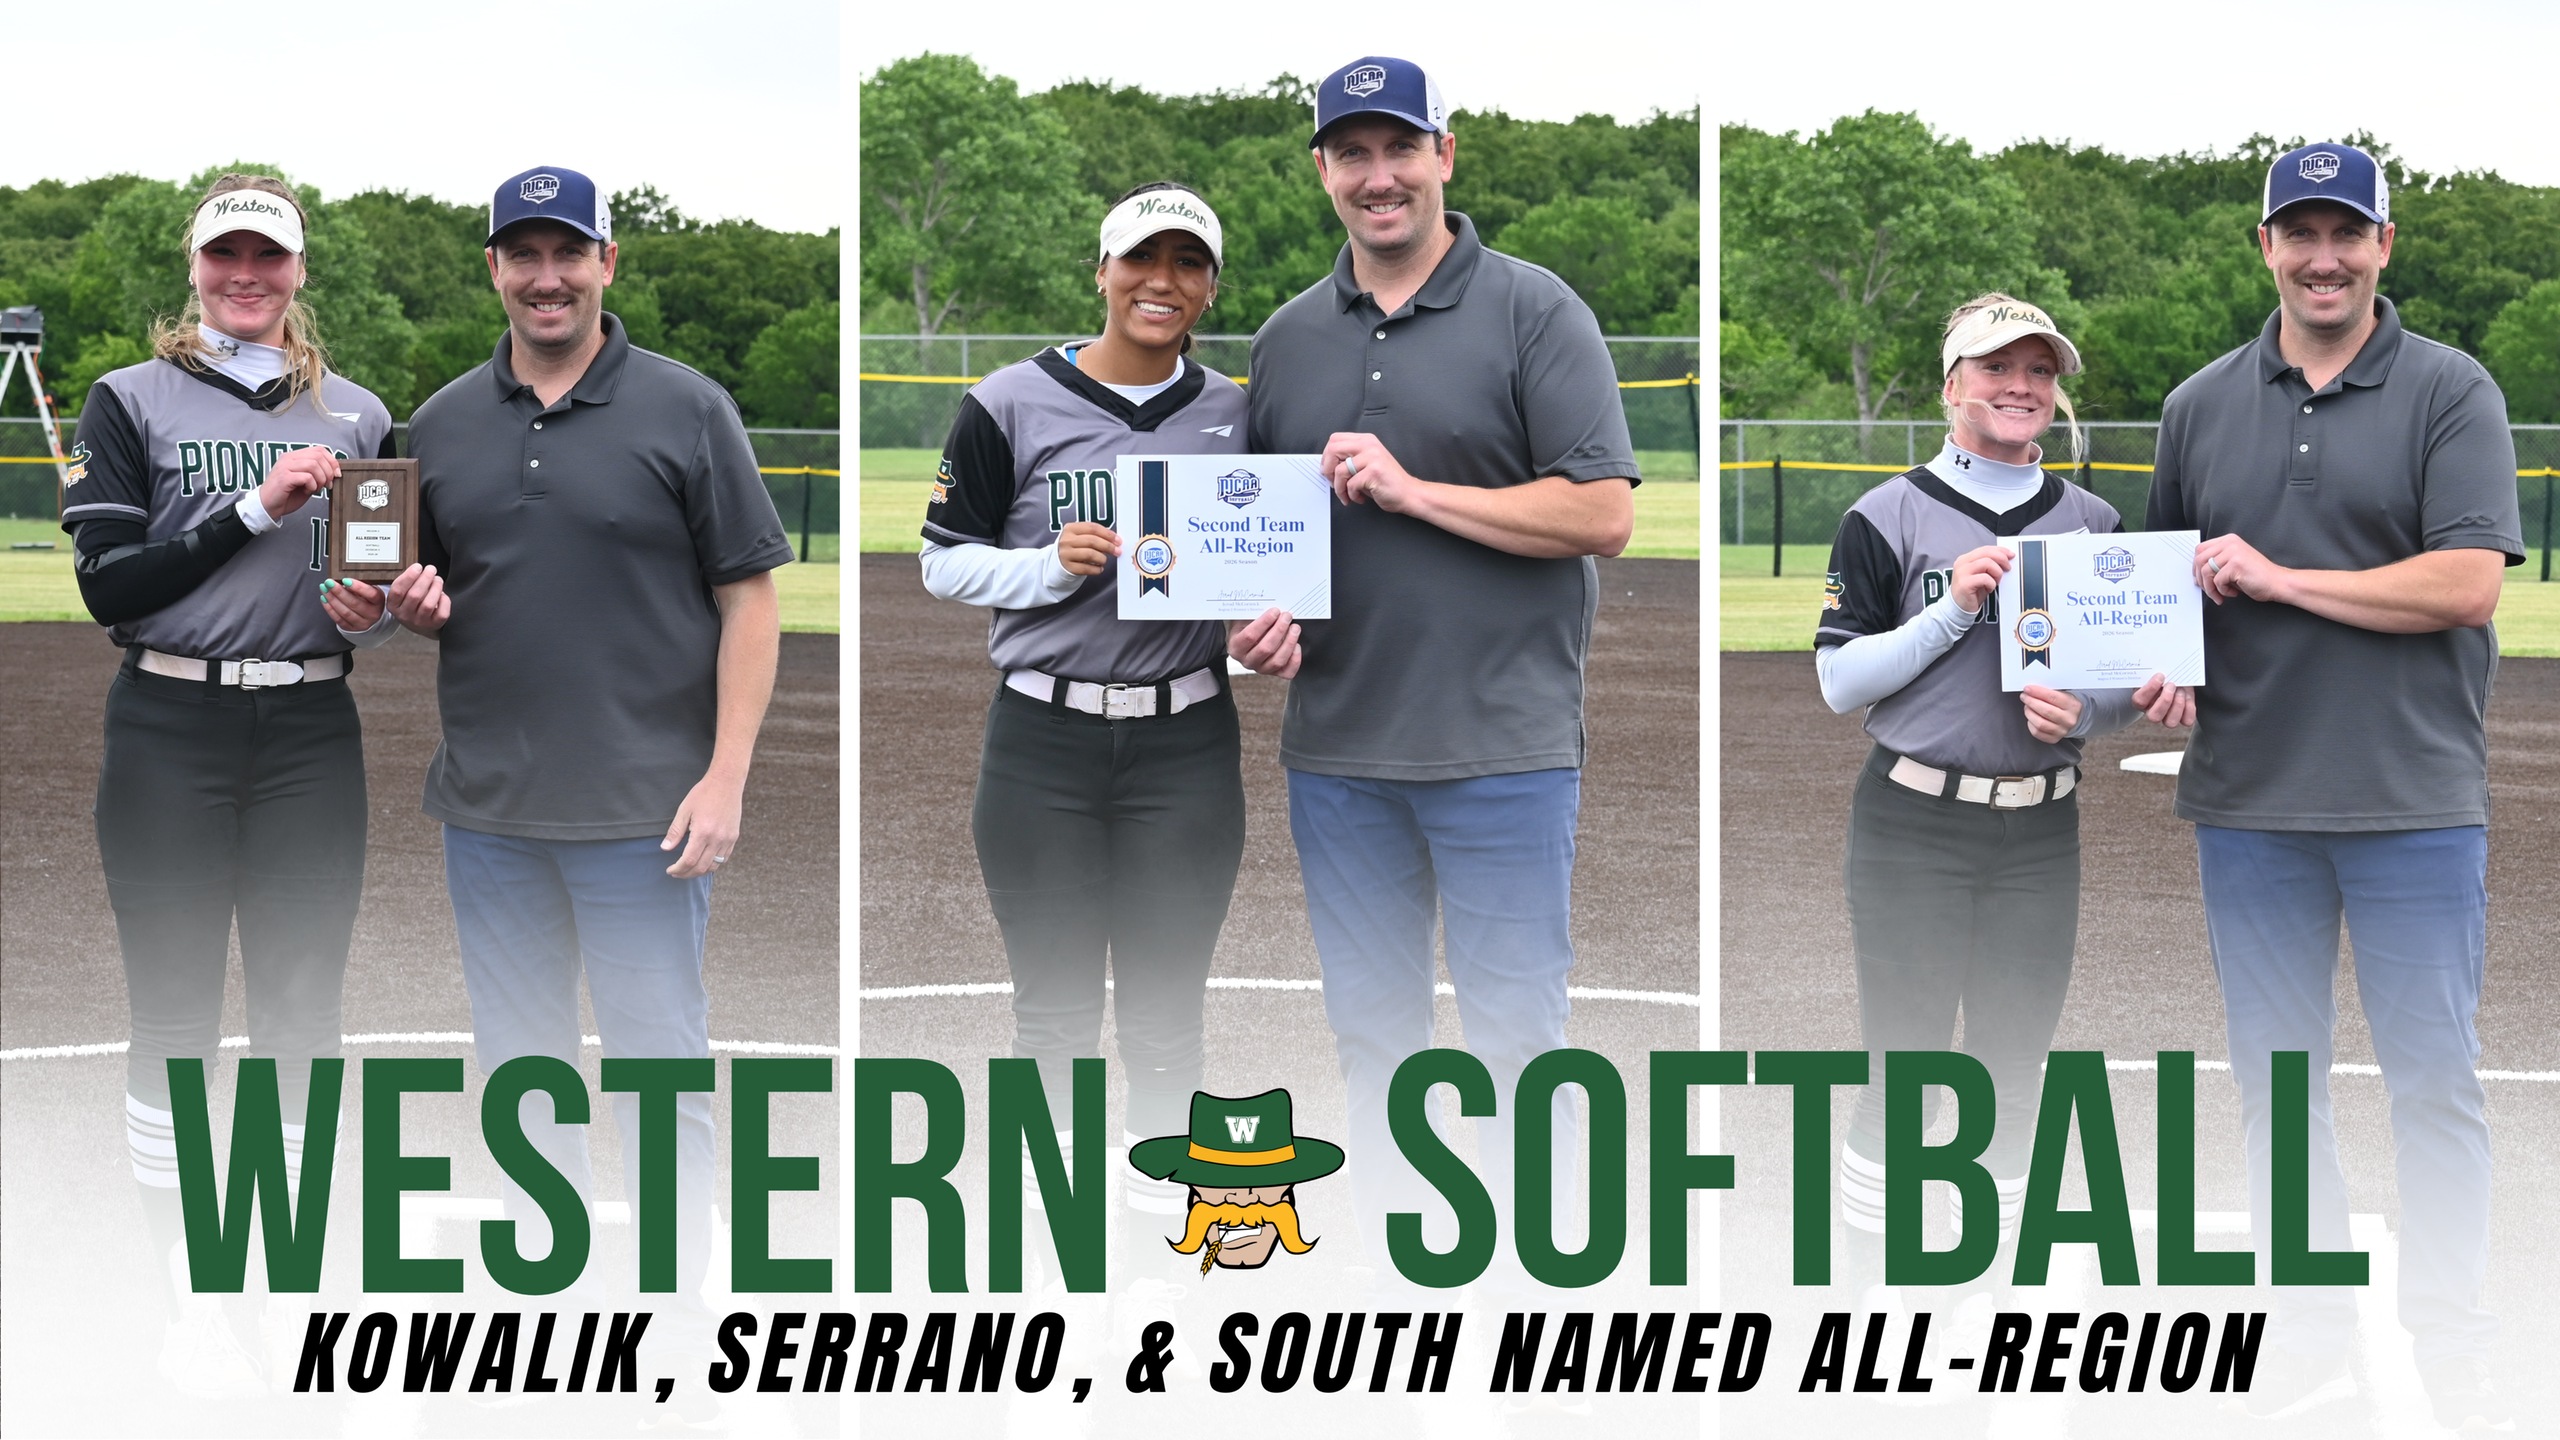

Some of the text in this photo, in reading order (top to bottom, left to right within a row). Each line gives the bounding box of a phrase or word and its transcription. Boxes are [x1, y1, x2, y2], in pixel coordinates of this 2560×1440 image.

[1346, 70, 1384, 90] NJCAA
[2301, 158, 2338, 174] NJCAA
[522, 180, 558, 197] NJCAA
[214, 198, 284, 220] Western
[1136, 198, 1208, 229] Western
[359, 486, 388, 500] NJCAA
[1220, 479, 1258, 497] NJCAA
[1187, 516, 1305, 533] Second Team
[1199, 537, 1294, 558] All-Region
[2096, 556, 2132, 572] NJCAA
[2066, 590, 2178, 606] Second Team
[2079, 610, 2168, 628] All-Region
